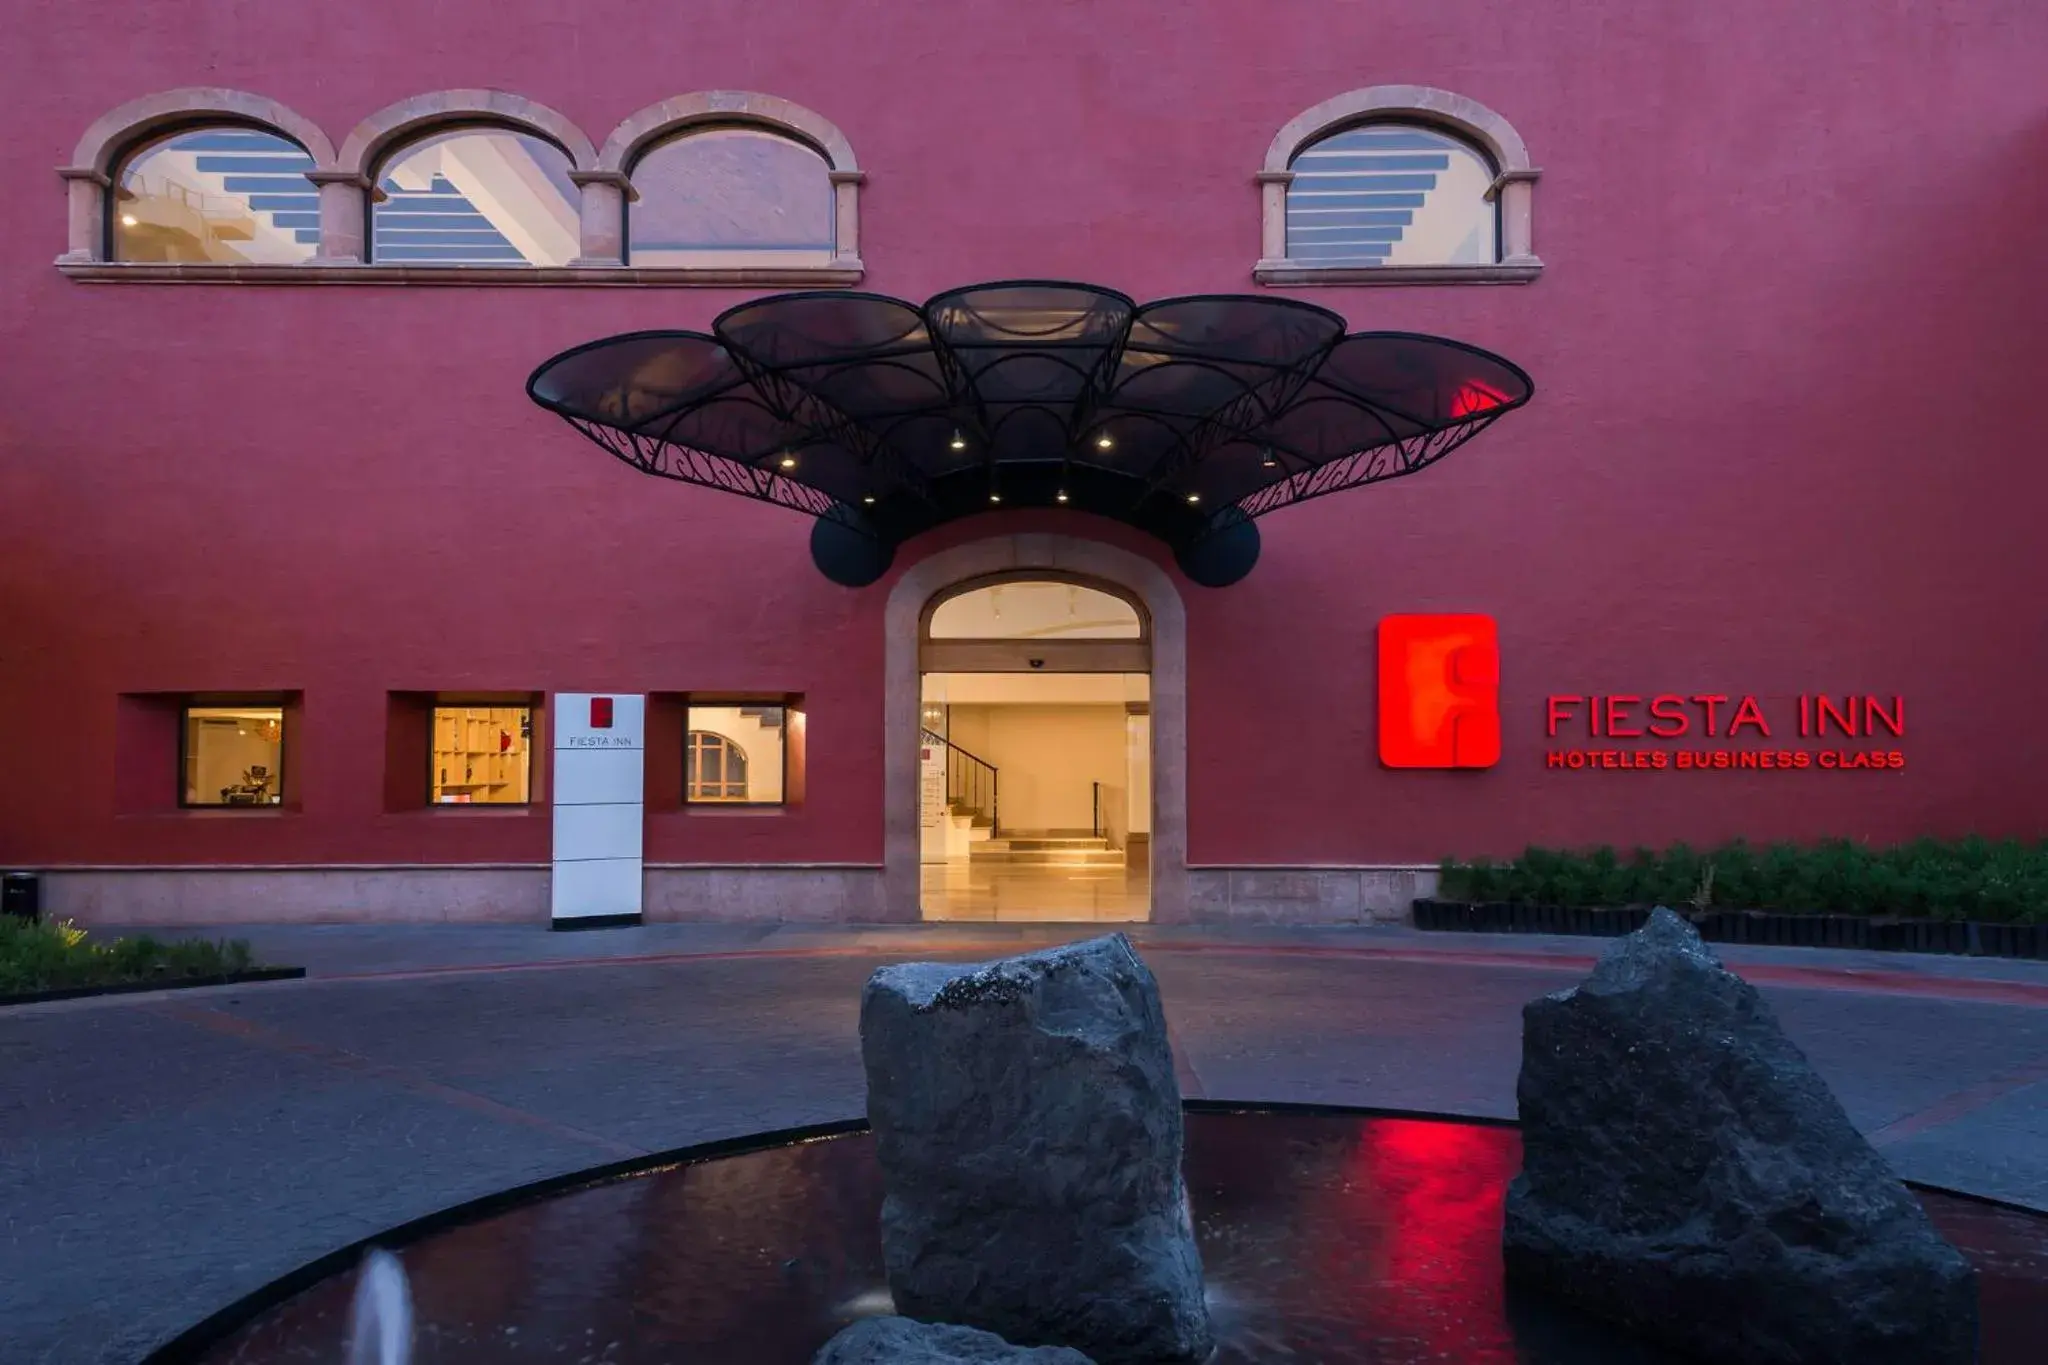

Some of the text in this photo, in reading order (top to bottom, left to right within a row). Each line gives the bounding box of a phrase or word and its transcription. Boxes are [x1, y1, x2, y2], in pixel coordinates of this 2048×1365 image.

[1547, 693, 1904, 737] FIESTA INN
[569, 736, 609, 746] FIESTA
[1548, 751, 1905, 769] HOTELES BUSINESS CLASS
